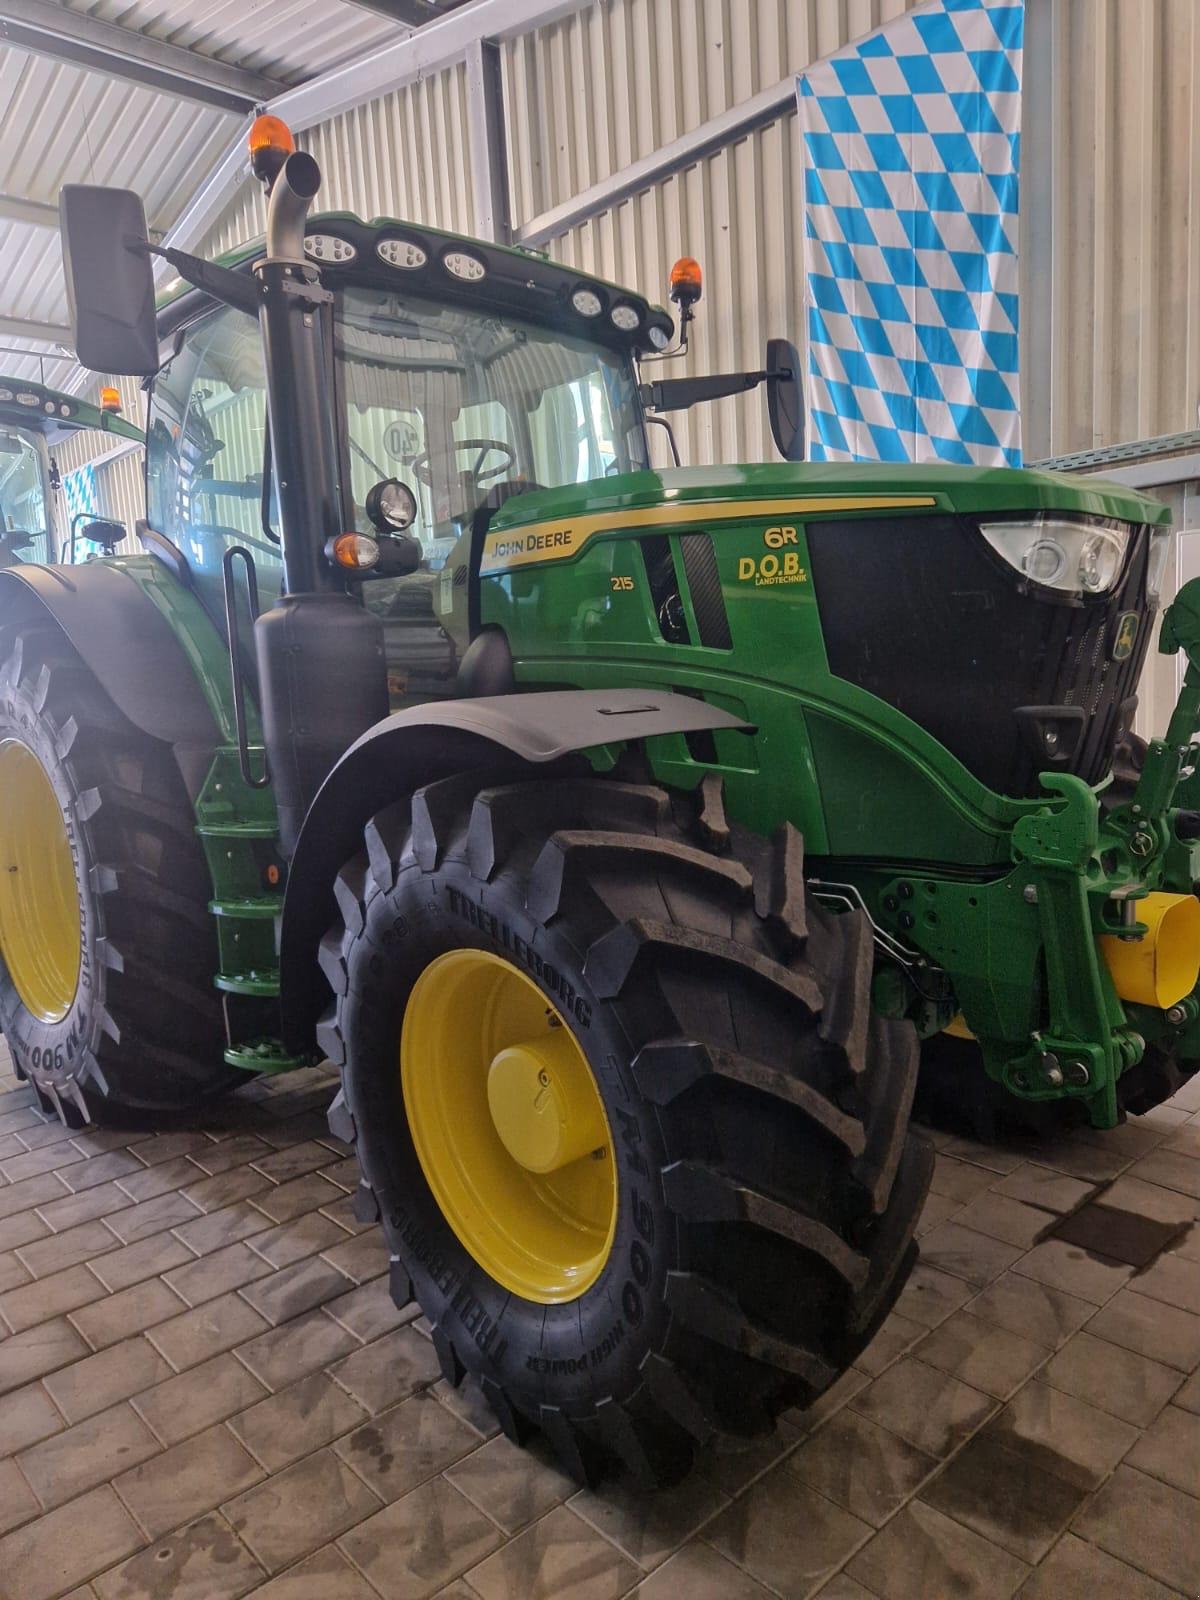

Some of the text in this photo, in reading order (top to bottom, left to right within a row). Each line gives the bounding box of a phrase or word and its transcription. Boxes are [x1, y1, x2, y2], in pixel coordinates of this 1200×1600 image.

[492, 530, 573, 558] JOHN DEERE
[764, 526, 799, 549] 6R
[738, 552, 804, 580] D.O.B.
[610, 576, 634, 591] 215
[755, 574, 807, 586] LANDTECHNIK
[446, 885, 593, 1029] TRELLEBORG
